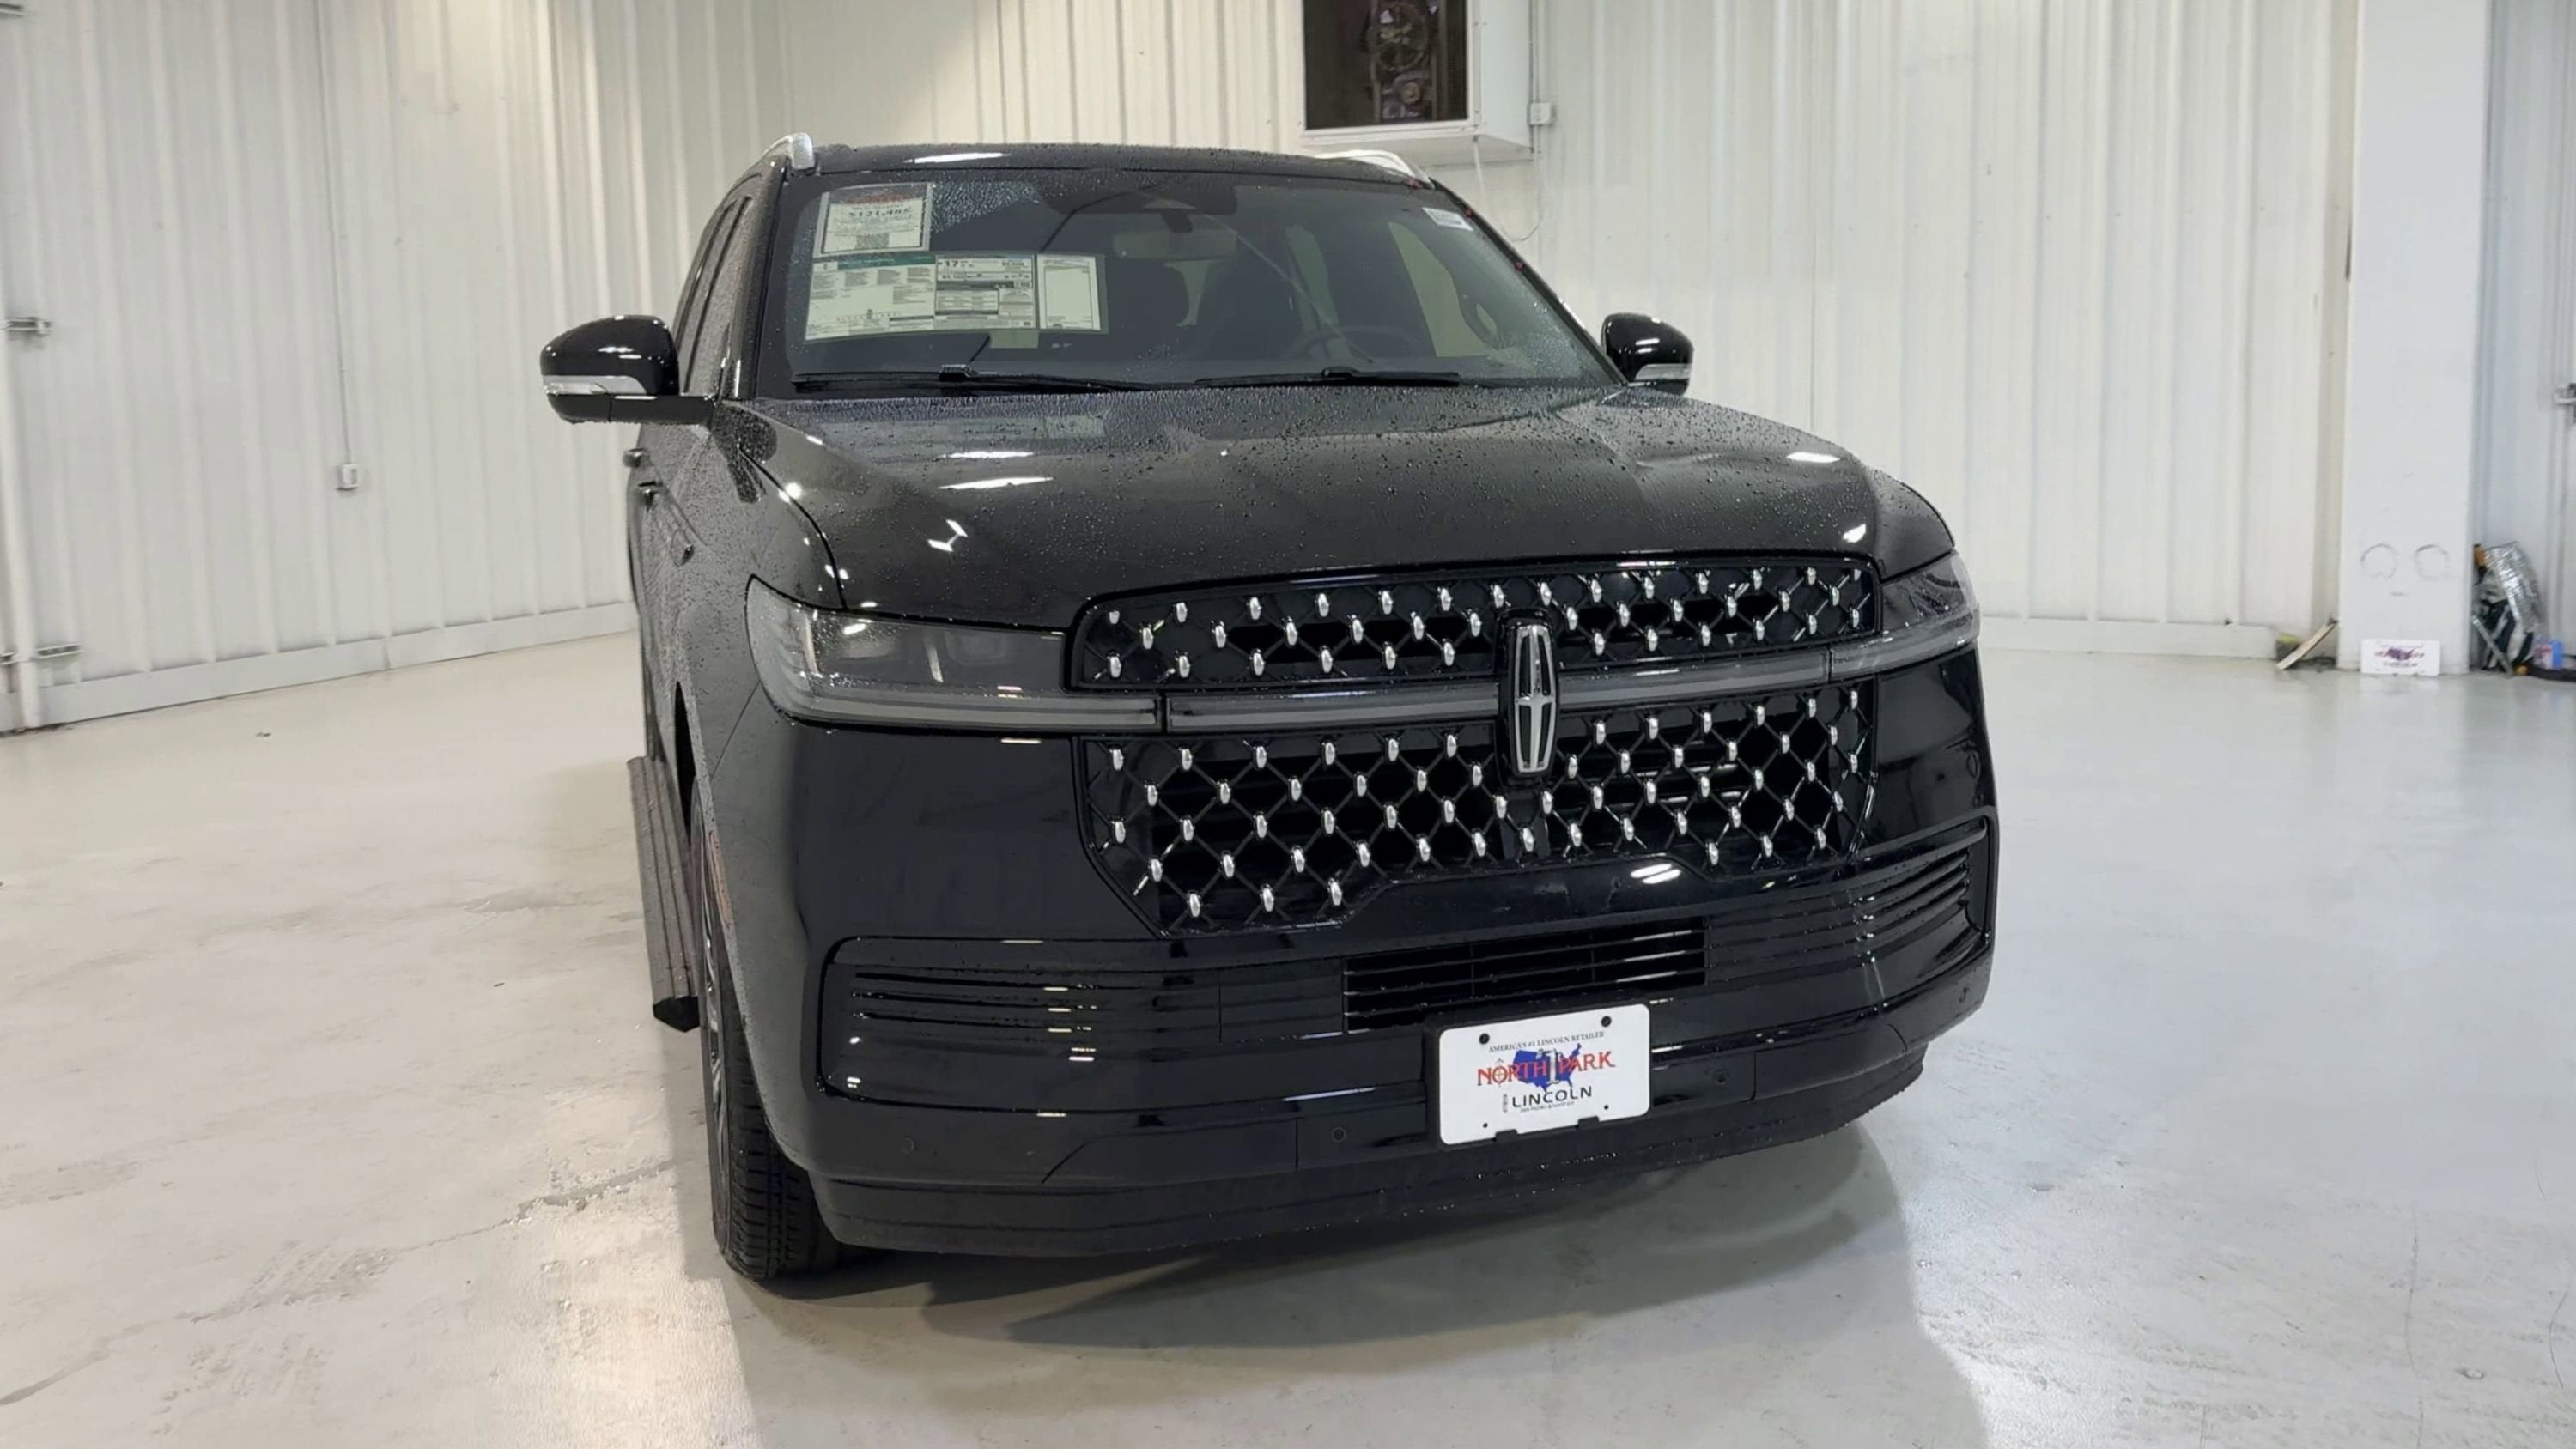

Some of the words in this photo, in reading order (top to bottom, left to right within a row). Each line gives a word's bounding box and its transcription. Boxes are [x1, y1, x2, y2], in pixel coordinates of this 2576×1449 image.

[1536, 1036, 1570, 1046] LINCOLN
[1571, 1031, 1605, 1041] RETAILER
[1477, 1058, 1546, 1087] NORTH
[1558, 1051, 1616, 1075] PARK
[1512, 1085, 1592, 1107] LINCOLN
